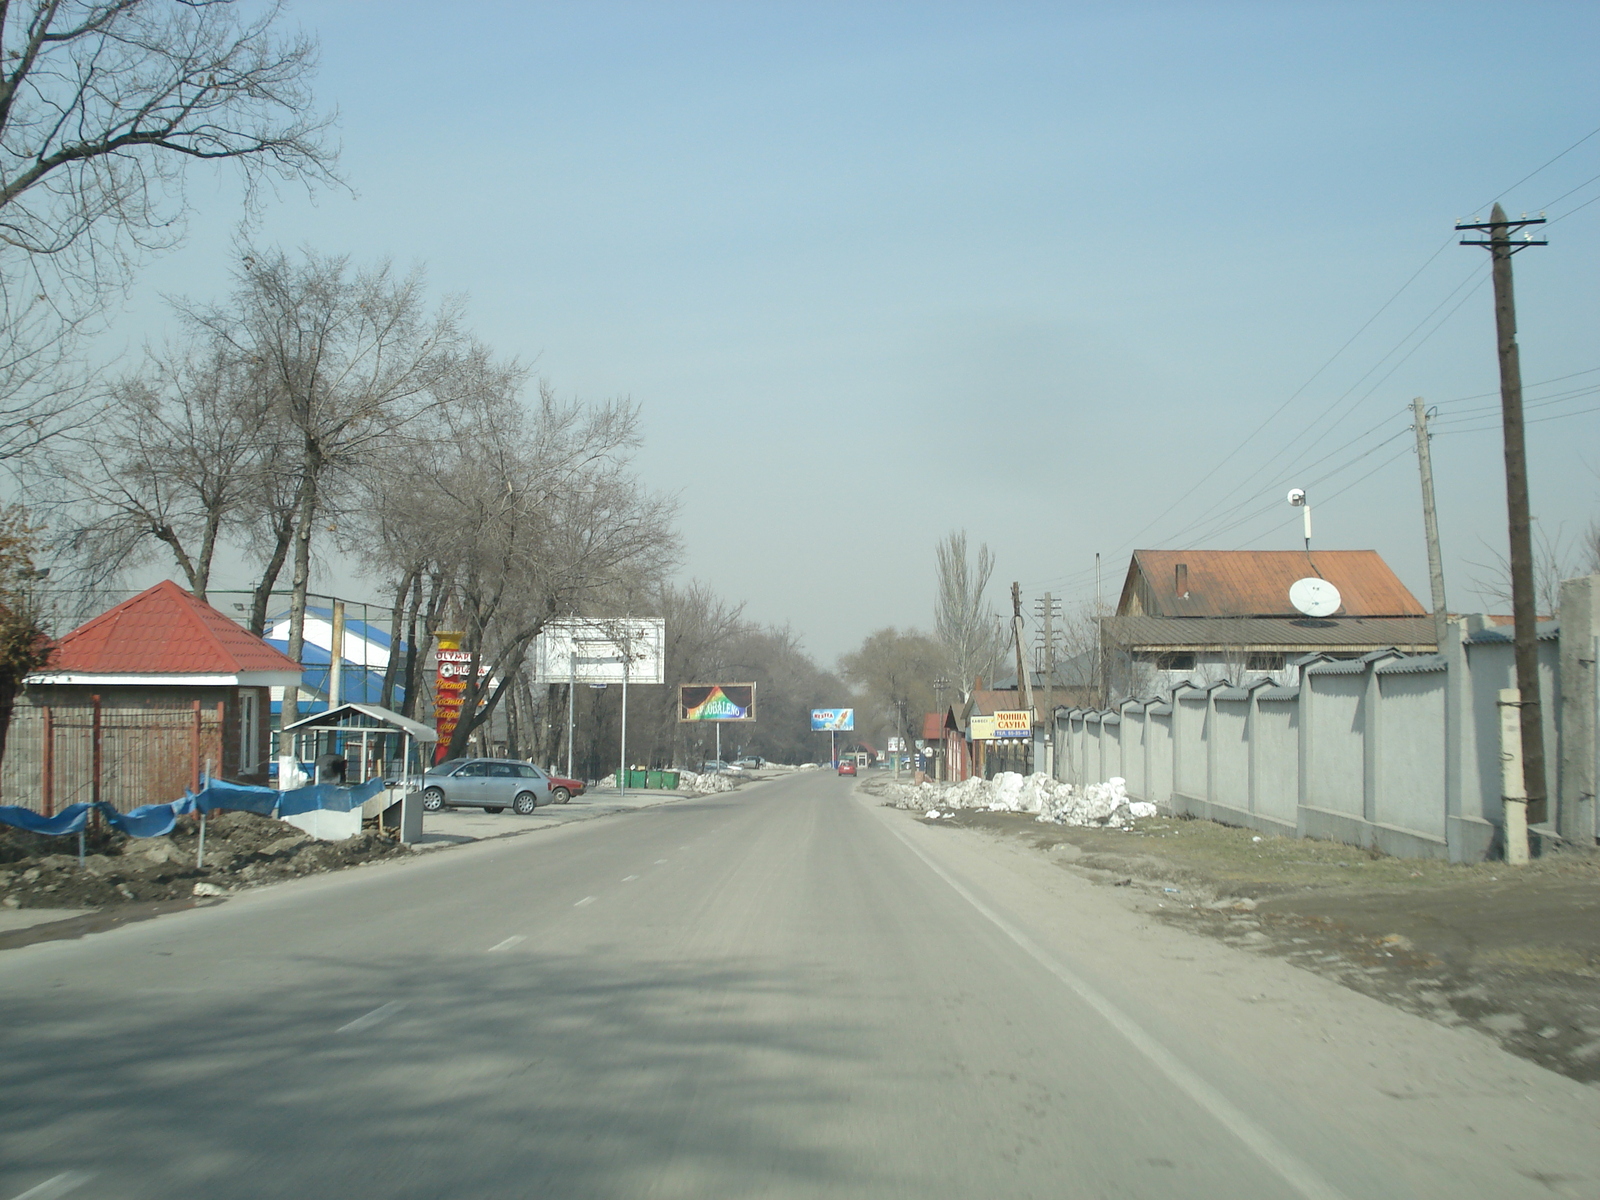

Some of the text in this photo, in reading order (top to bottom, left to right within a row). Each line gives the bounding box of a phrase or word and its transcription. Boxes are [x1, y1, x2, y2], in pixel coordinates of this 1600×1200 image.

[435, 652, 482, 661] OLYMPI
[454, 665, 486, 676] PLAA
[998, 721, 1027, 729] САУНА
